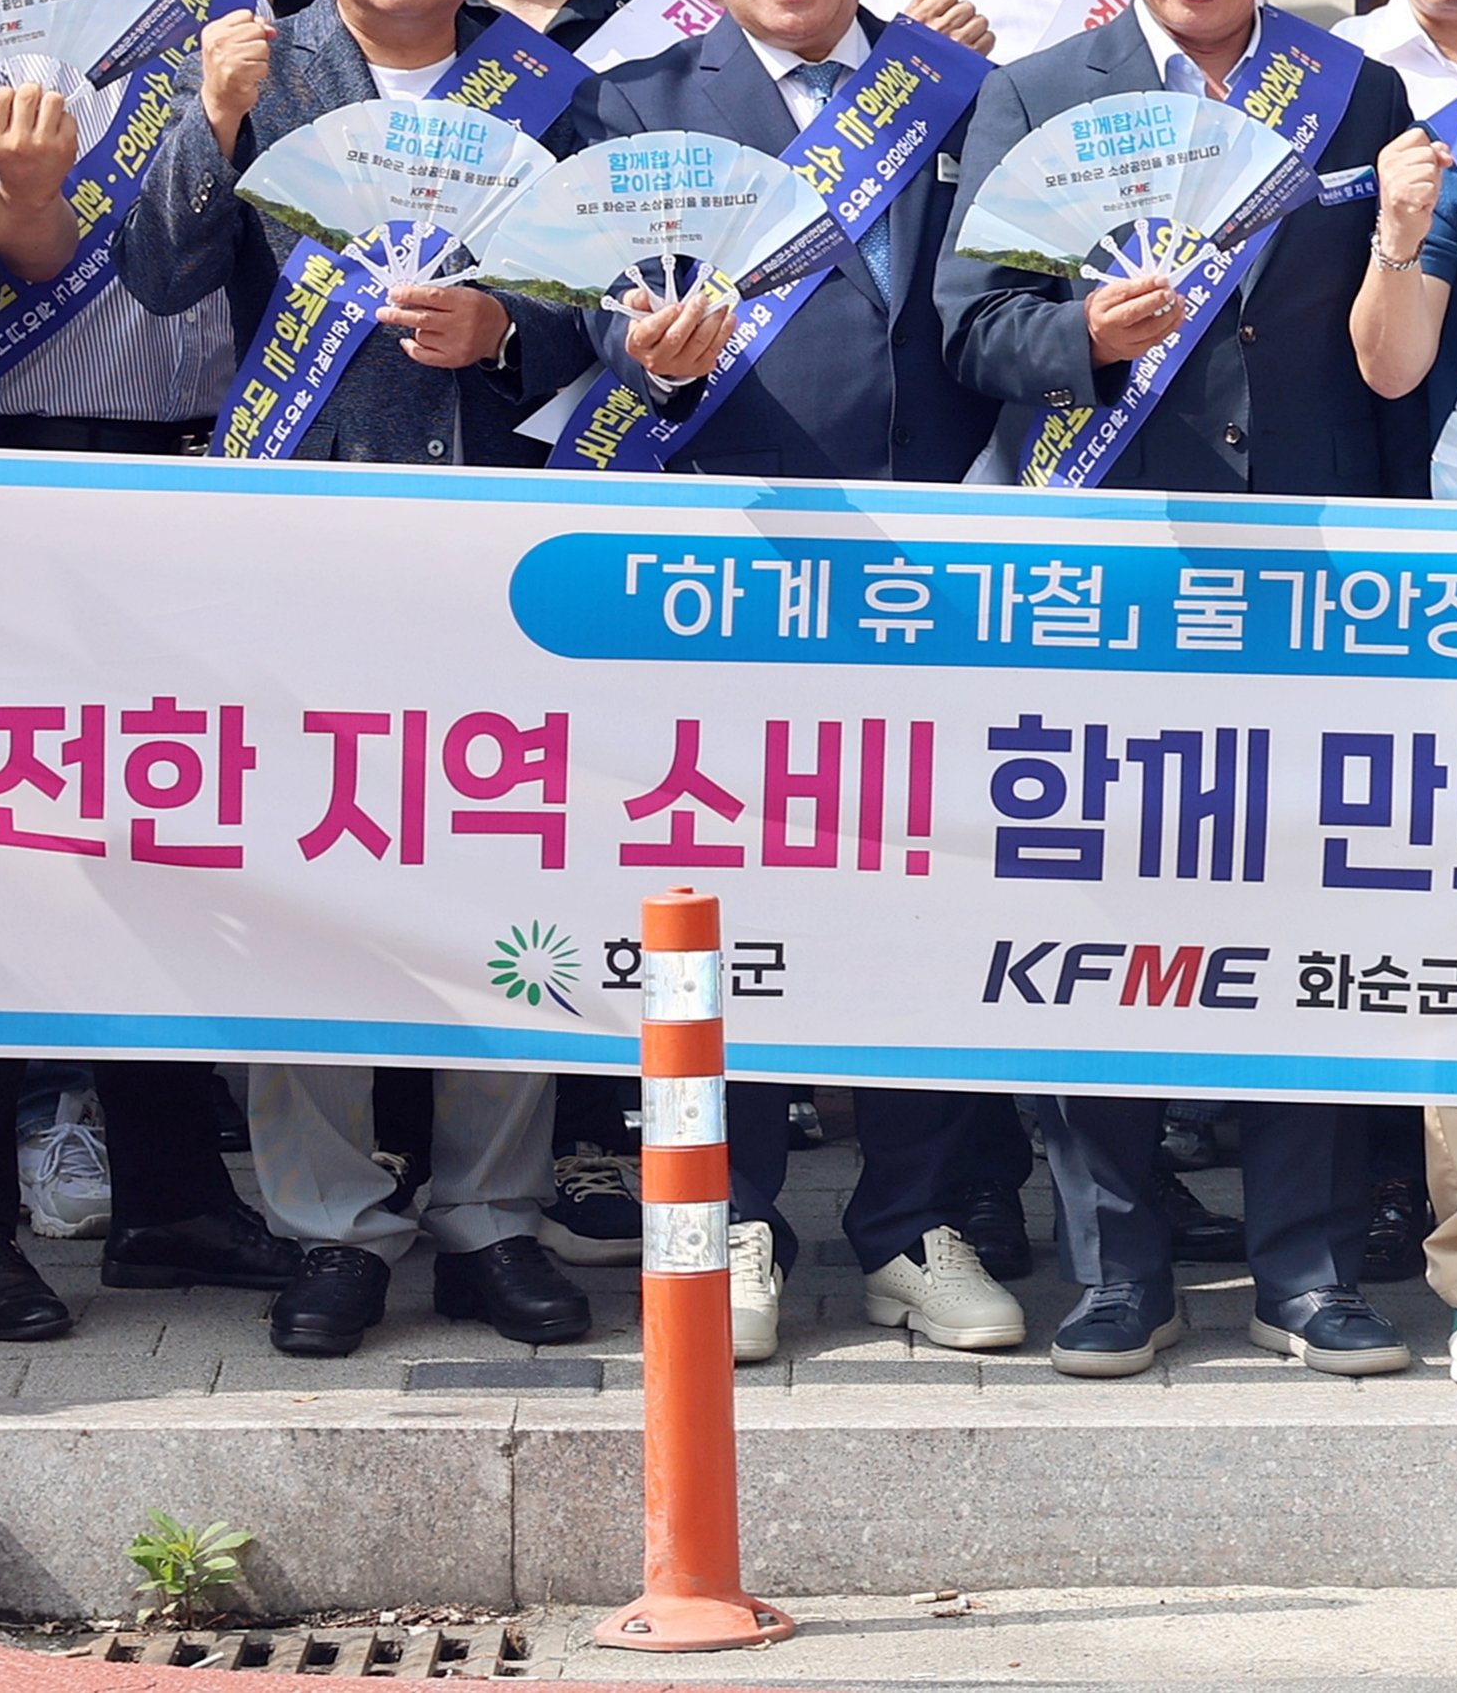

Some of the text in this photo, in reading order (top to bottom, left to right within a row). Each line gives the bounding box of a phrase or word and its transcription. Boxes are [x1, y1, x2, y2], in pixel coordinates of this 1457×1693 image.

[389, 110, 488, 144] 함께합시다
[834, 57, 921, 151] 성장하는
[1071, 103, 1173, 140] 함께합시다
[384, 130, 484, 166] 같이삽시다
[608, 146, 713, 172] 함께합시다
[838, 118, 929, 224] 소상공인이 살아야
[1075, 125, 1177, 163] 같이삽시다
[610, 168, 715, 194] 같이삽시다
[261, 254, 345, 383] 함께하는
[305, 300, 367, 389] 화순경제도
[628, 555, 829, 645] 「하계
[861, 557, 1138, 649] 휴가철」
[299, 709, 569, 869] 지역
[620, 718, 933, 878] 소비!
[986, 713, 1271, 884] 함께
[601, 938, 786, 997] 화군
[980, 939, 1272, 1011] KFME
